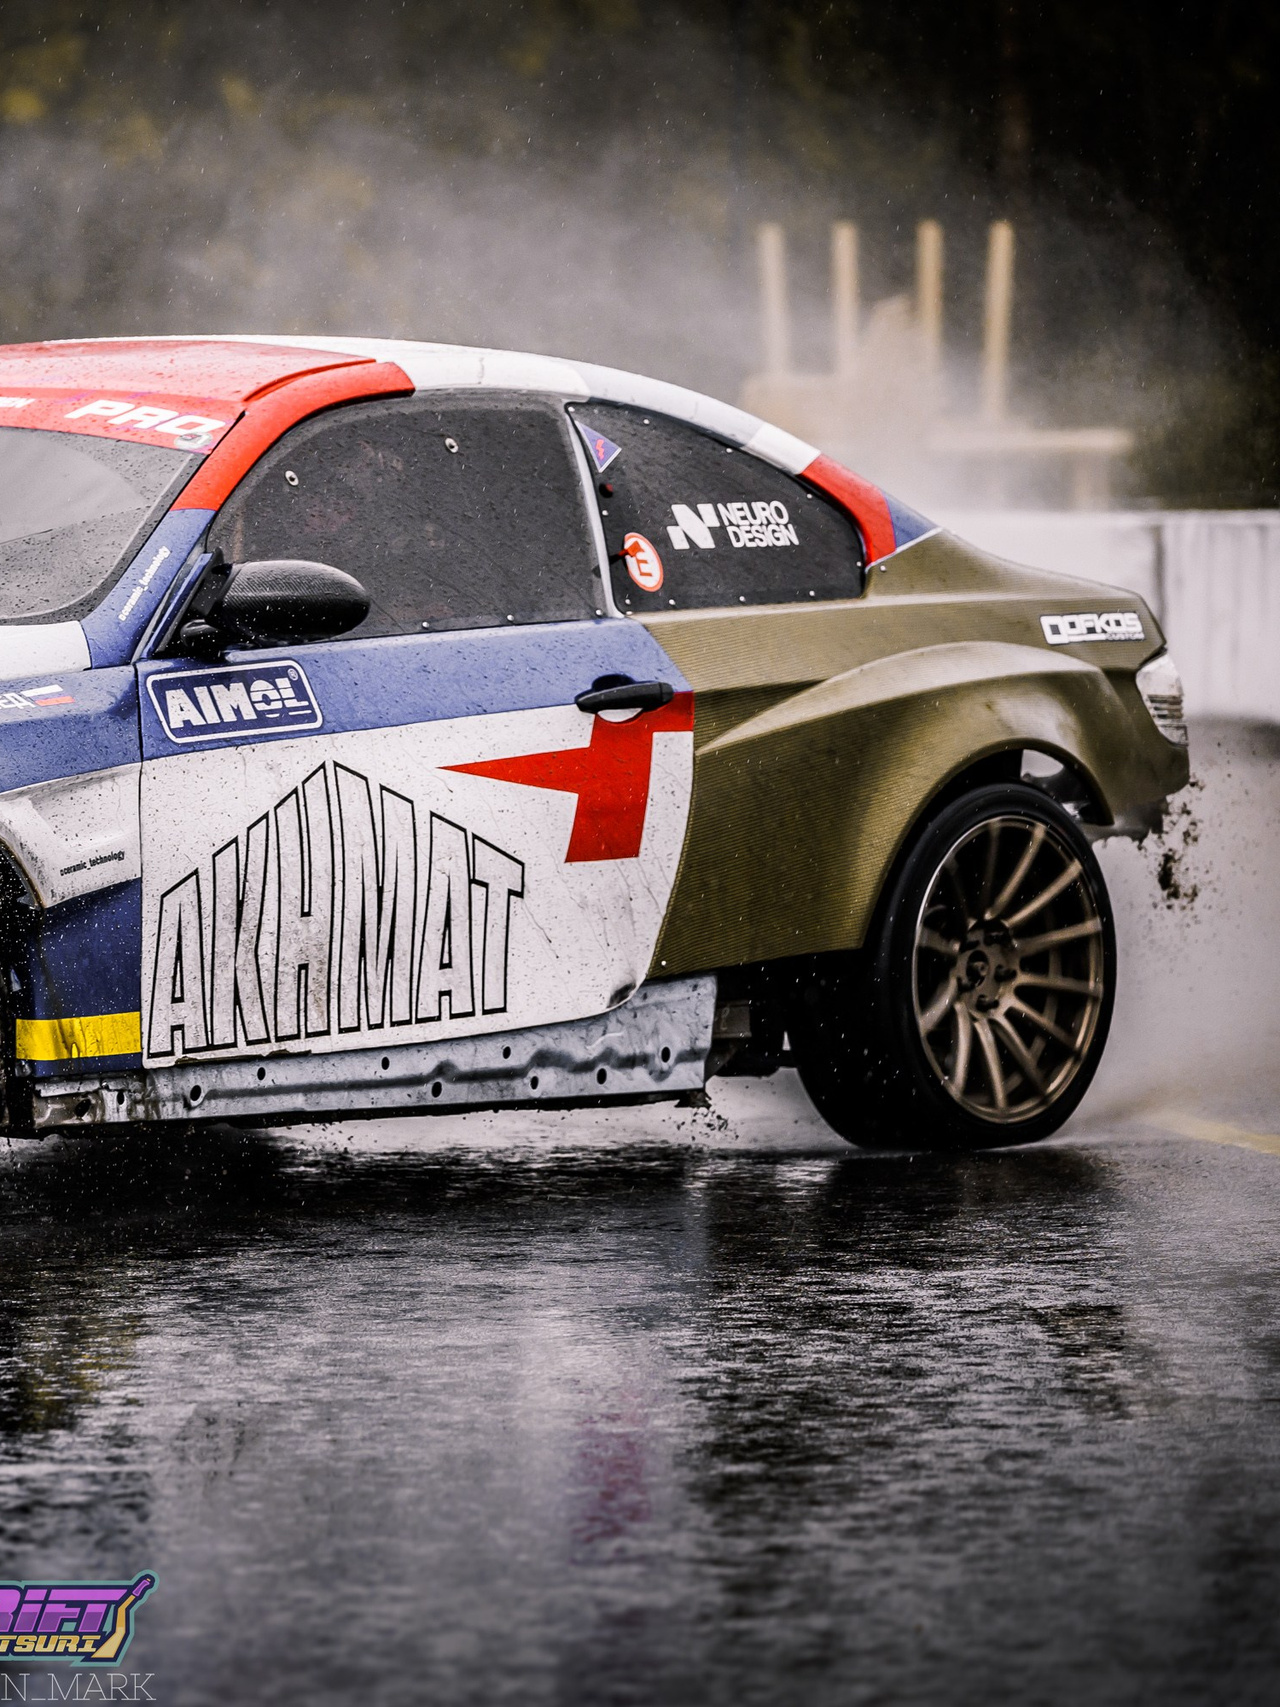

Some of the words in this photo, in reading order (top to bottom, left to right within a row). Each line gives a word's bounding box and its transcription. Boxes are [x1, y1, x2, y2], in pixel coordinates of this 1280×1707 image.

[64, 399, 227, 436] PRO
[717, 500, 790, 527] NEURO
[726, 524, 800, 548] DESIGN
[165, 676, 310, 730] AIMOL
[146, 761, 525, 1059] AKHMAT
